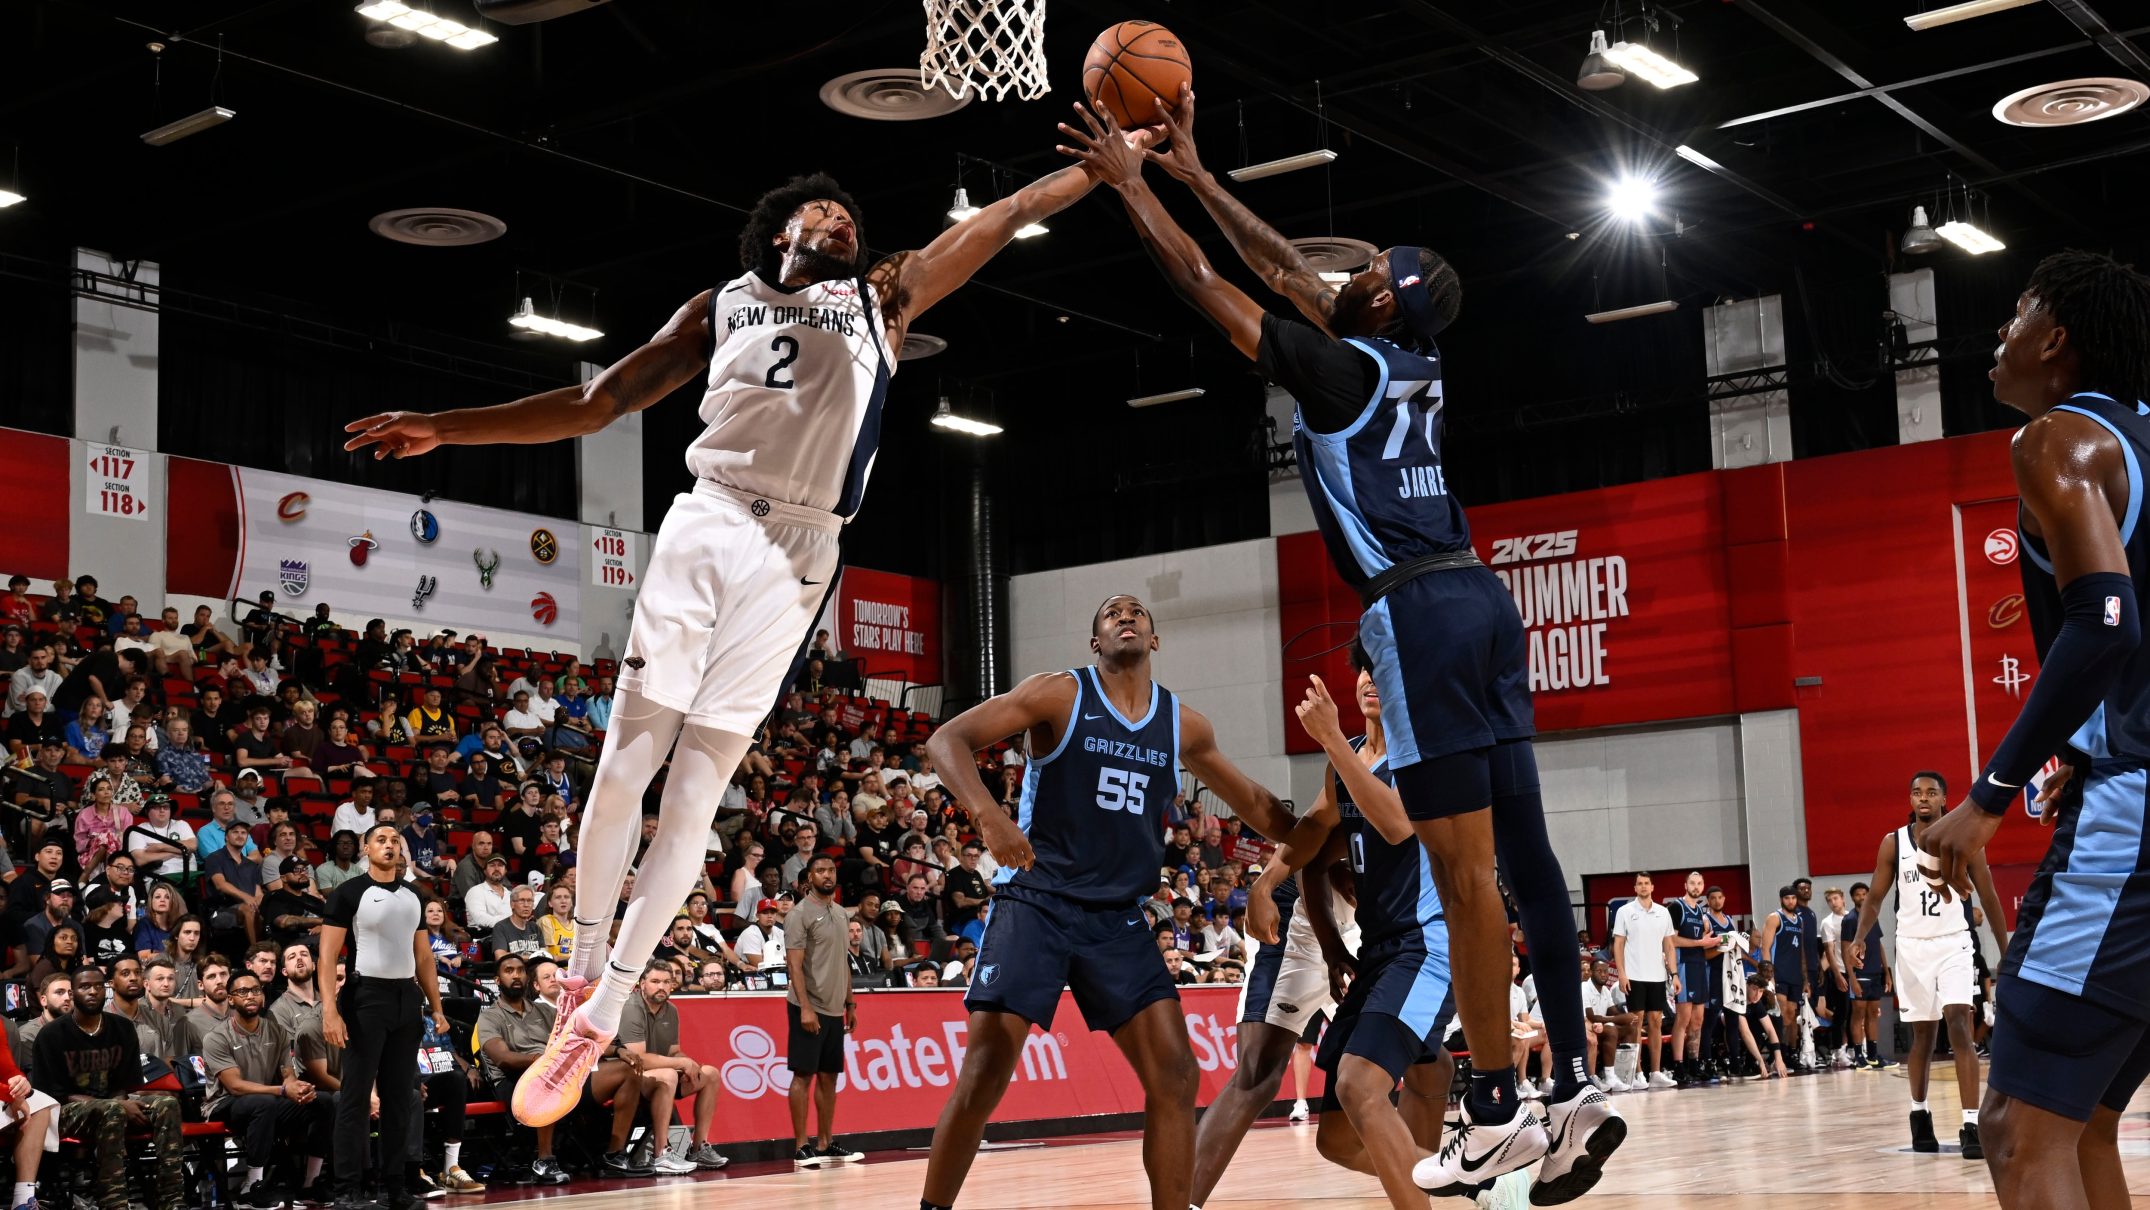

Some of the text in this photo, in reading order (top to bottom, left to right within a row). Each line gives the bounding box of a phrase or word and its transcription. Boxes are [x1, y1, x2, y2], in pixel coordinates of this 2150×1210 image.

[727, 305, 855, 337] NEW ORLEANS
[765, 335, 799, 389] 2
[105, 447, 131, 459] SECTION
[101, 456, 135, 480] 117
[1398, 465, 1447, 498] JARRE
[104, 482, 130, 493] SECTION
[100, 491, 133, 515] 118
[601, 536, 625, 557] 118
[604, 529, 622, 538] SECTION
[1490, 529, 1578, 565] 2K25
[602, 566, 625, 586] 119
[604, 558, 623, 567] SECTION
[280, 571, 307, 582] KINGS
[853, 598, 909, 629] TOMORROW'S
[853, 623, 924, 655] STARS PLAY HERE
[1528, 622, 1610, 692] AGUE
[1083, 736, 1168, 768] GRIZZLIES
[1095, 766, 1151, 815] 55
[1350, 832, 1365, 874] 0
[1903, 869, 1920, 884] NEW
[1919, 890, 1941, 917] 12
[1791, 935, 1799, 948] 4
[835, 1020, 1068, 1093] tateFm
